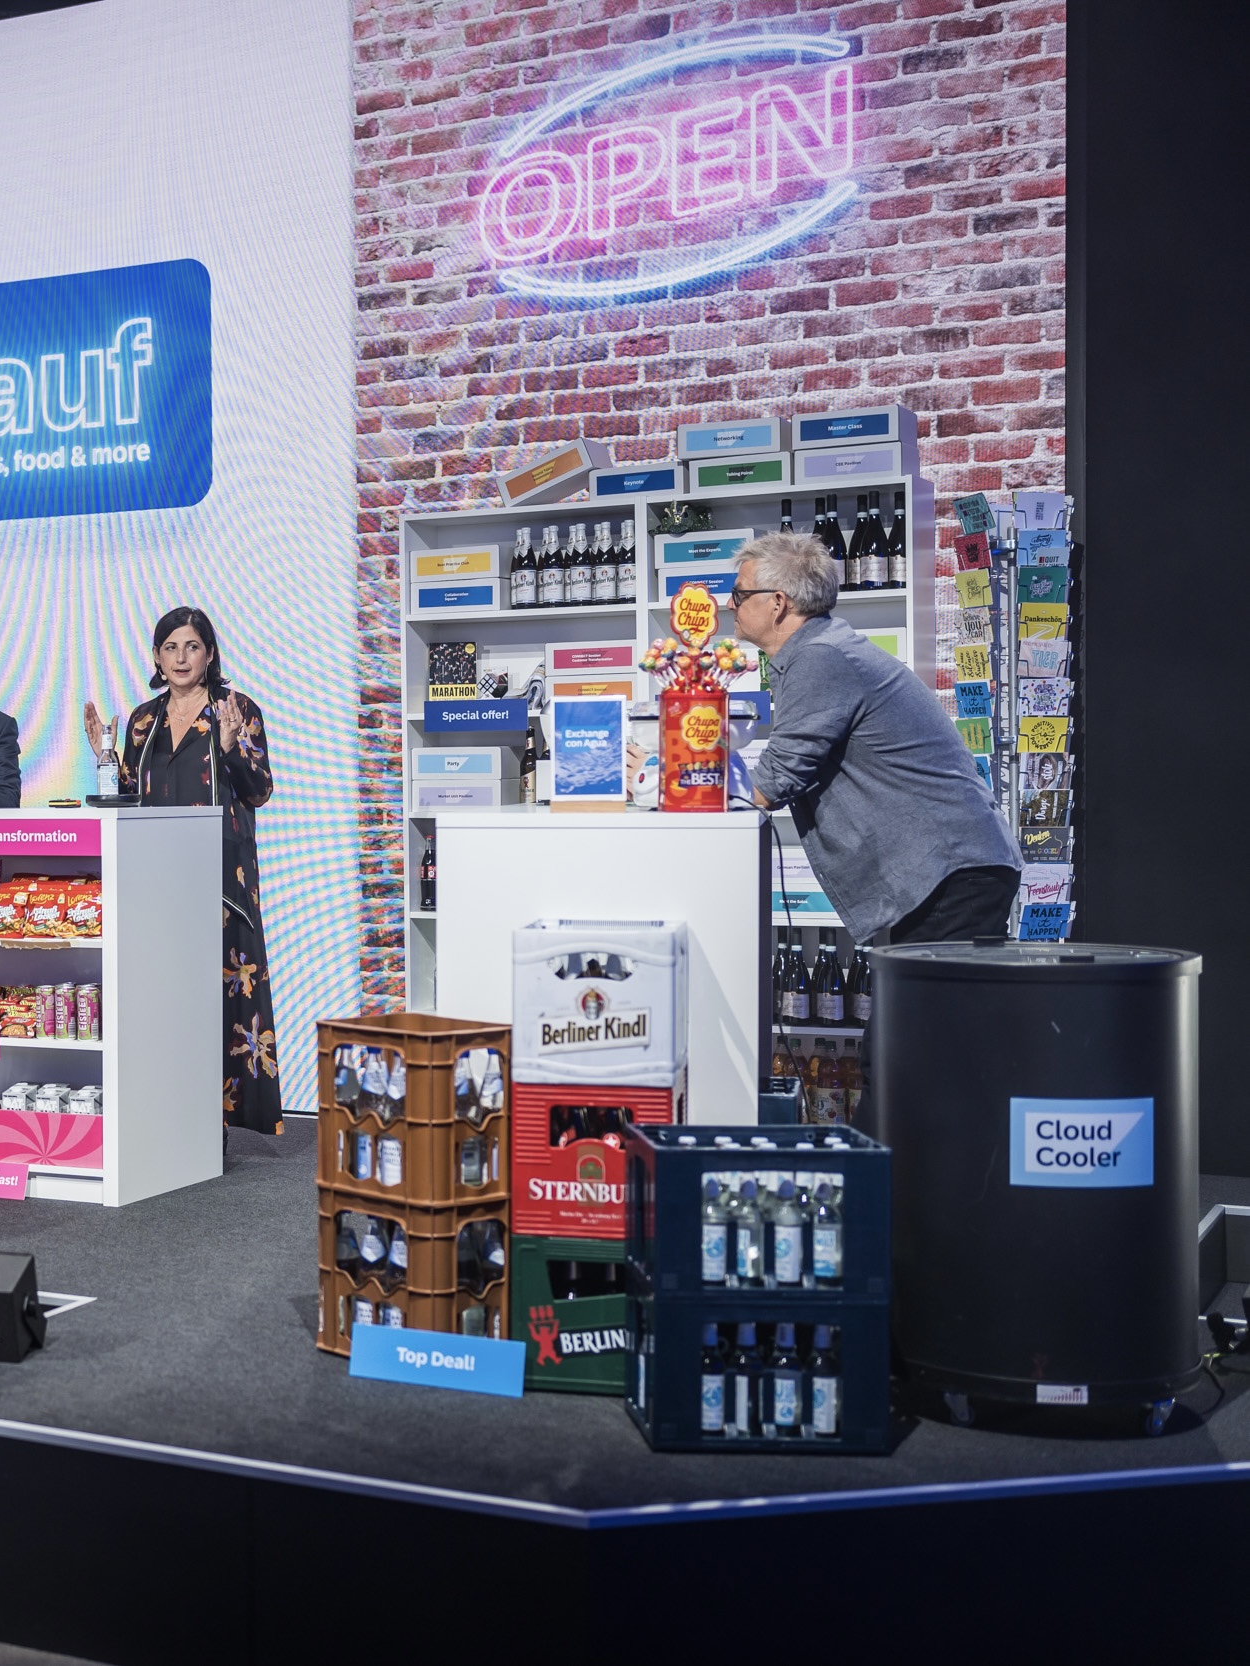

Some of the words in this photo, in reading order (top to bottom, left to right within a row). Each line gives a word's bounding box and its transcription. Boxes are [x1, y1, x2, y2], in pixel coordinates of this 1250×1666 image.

[479, 64, 853, 262] OPEN
[13, 445, 65, 474] food
[69, 445, 88, 468] &
[91, 442, 150, 465] more
[623, 479, 644, 487] Keynote
[680, 598, 711, 615] Chupa
[678, 612, 710, 631] Chups
[1024, 615, 1063, 623] Dankeschön
[431, 686, 476, 697] MARATHON
[960, 685, 984, 697] MAKE
[442, 711, 480, 723] Special
[481, 711, 509, 720] offer!
[963, 707, 987, 715] HAPPEN
[687, 715, 720, 729] Chupa
[1031, 720, 1056, 733] POSITIVITY
[565, 729, 610, 740] Exchange
[685, 727, 719, 740] Chups
[583, 739, 608, 749] Agua
[691, 772, 720, 785] BEST
[1030, 907, 1062, 918] MAKE
[1027, 927, 1059, 936] HAPPEN
[541, 1021, 602, 1046] Berliner
[604, 1014, 647, 1040] Kindl
[1036, 1120, 1112, 1141] Cloud
[1036, 1146, 1121, 1168] Cooler
[396, 1346, 428, 1369] Top
[430, 1350, 475, 1372] Deal!
